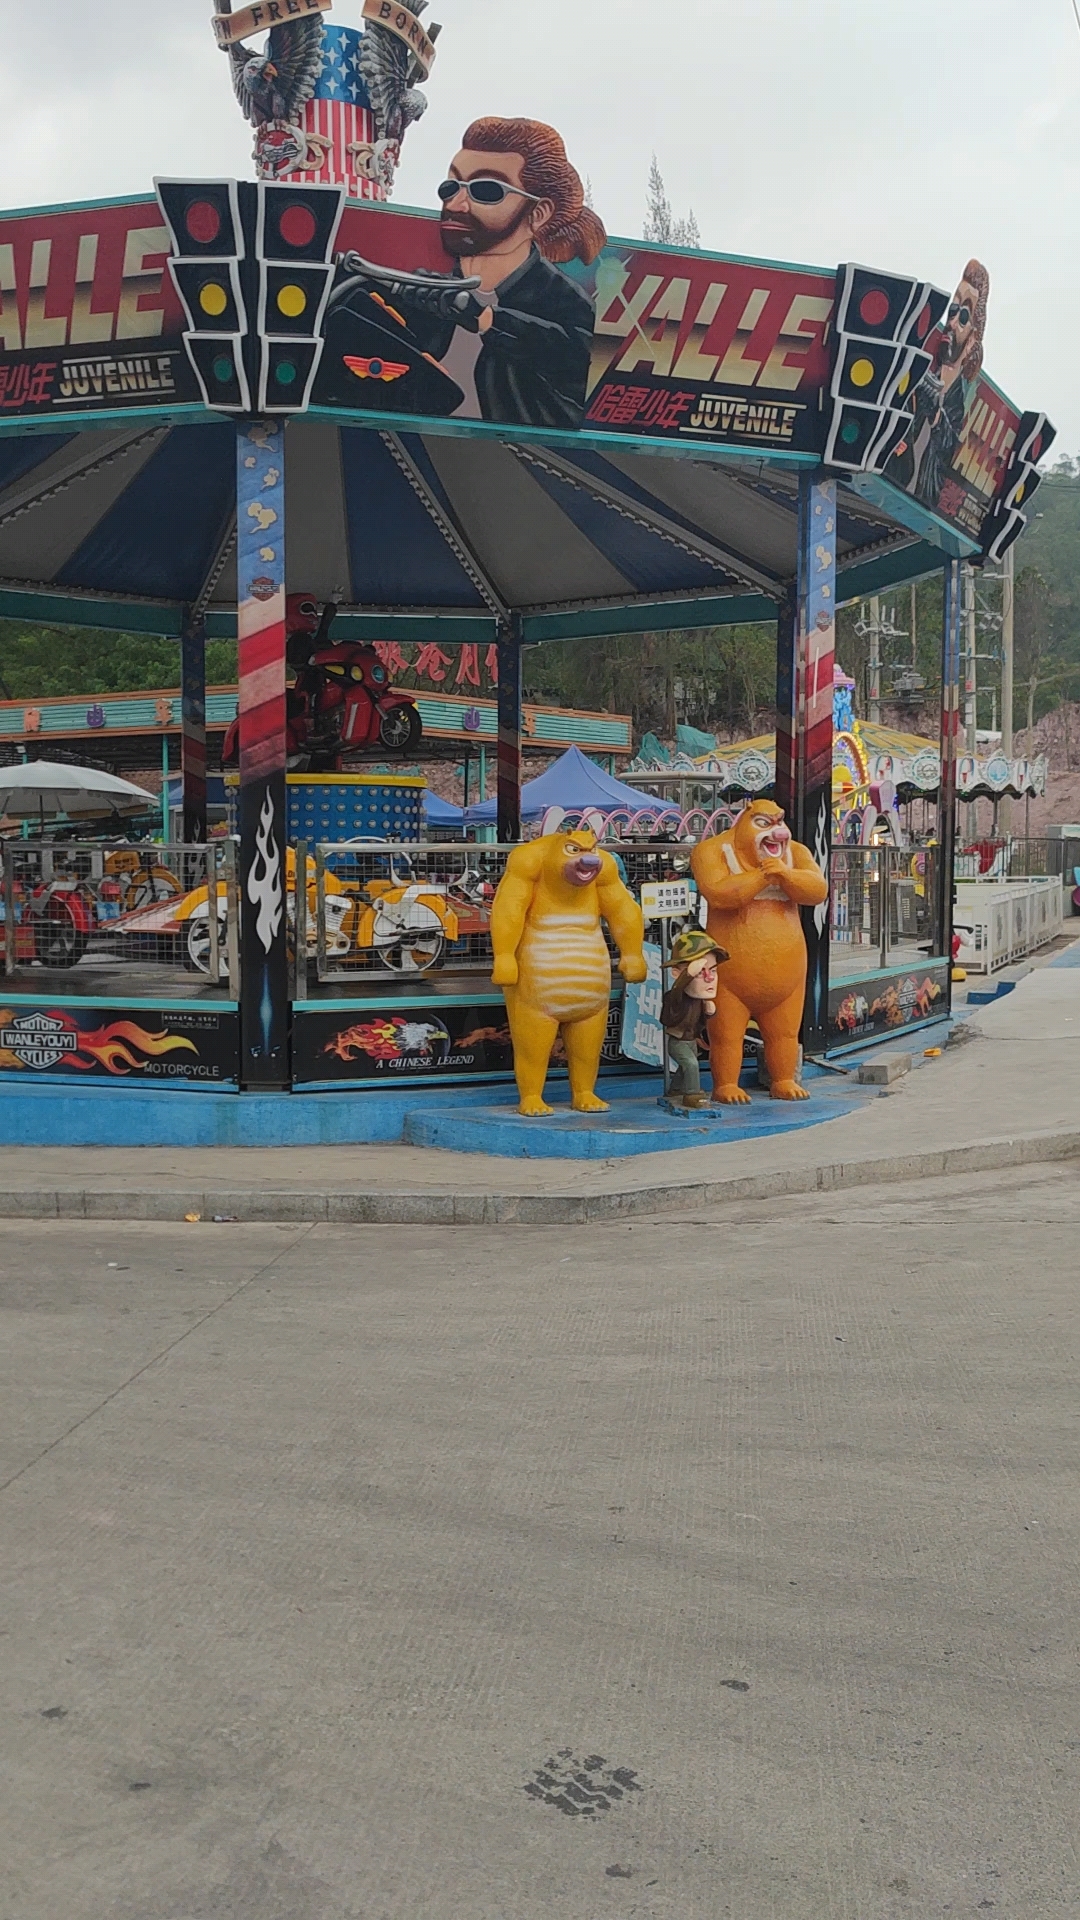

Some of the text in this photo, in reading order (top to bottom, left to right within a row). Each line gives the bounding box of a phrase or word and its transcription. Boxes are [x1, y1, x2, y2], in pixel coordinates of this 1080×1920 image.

[378, 3, 428, 57] BORN
[59, 357, 175, 397] JUVENILE
[585, 383, 697, 429] 哈雷少年
[690, 399, 797, 437] JUVENILE
[20, 1017, 57, 1031] MOTOR
[5, 1033, 73, 1048] WANLEYOUYI
[20, 1050, 58, 1065] CYCLES
[376, 1060, 384, 1069] A
[388, 1057, 433, 1068] CHINESE
[437, 1055, 475, 1066] LEGEND
[144, 1063, 220, 1077] MOTORCYCLE
